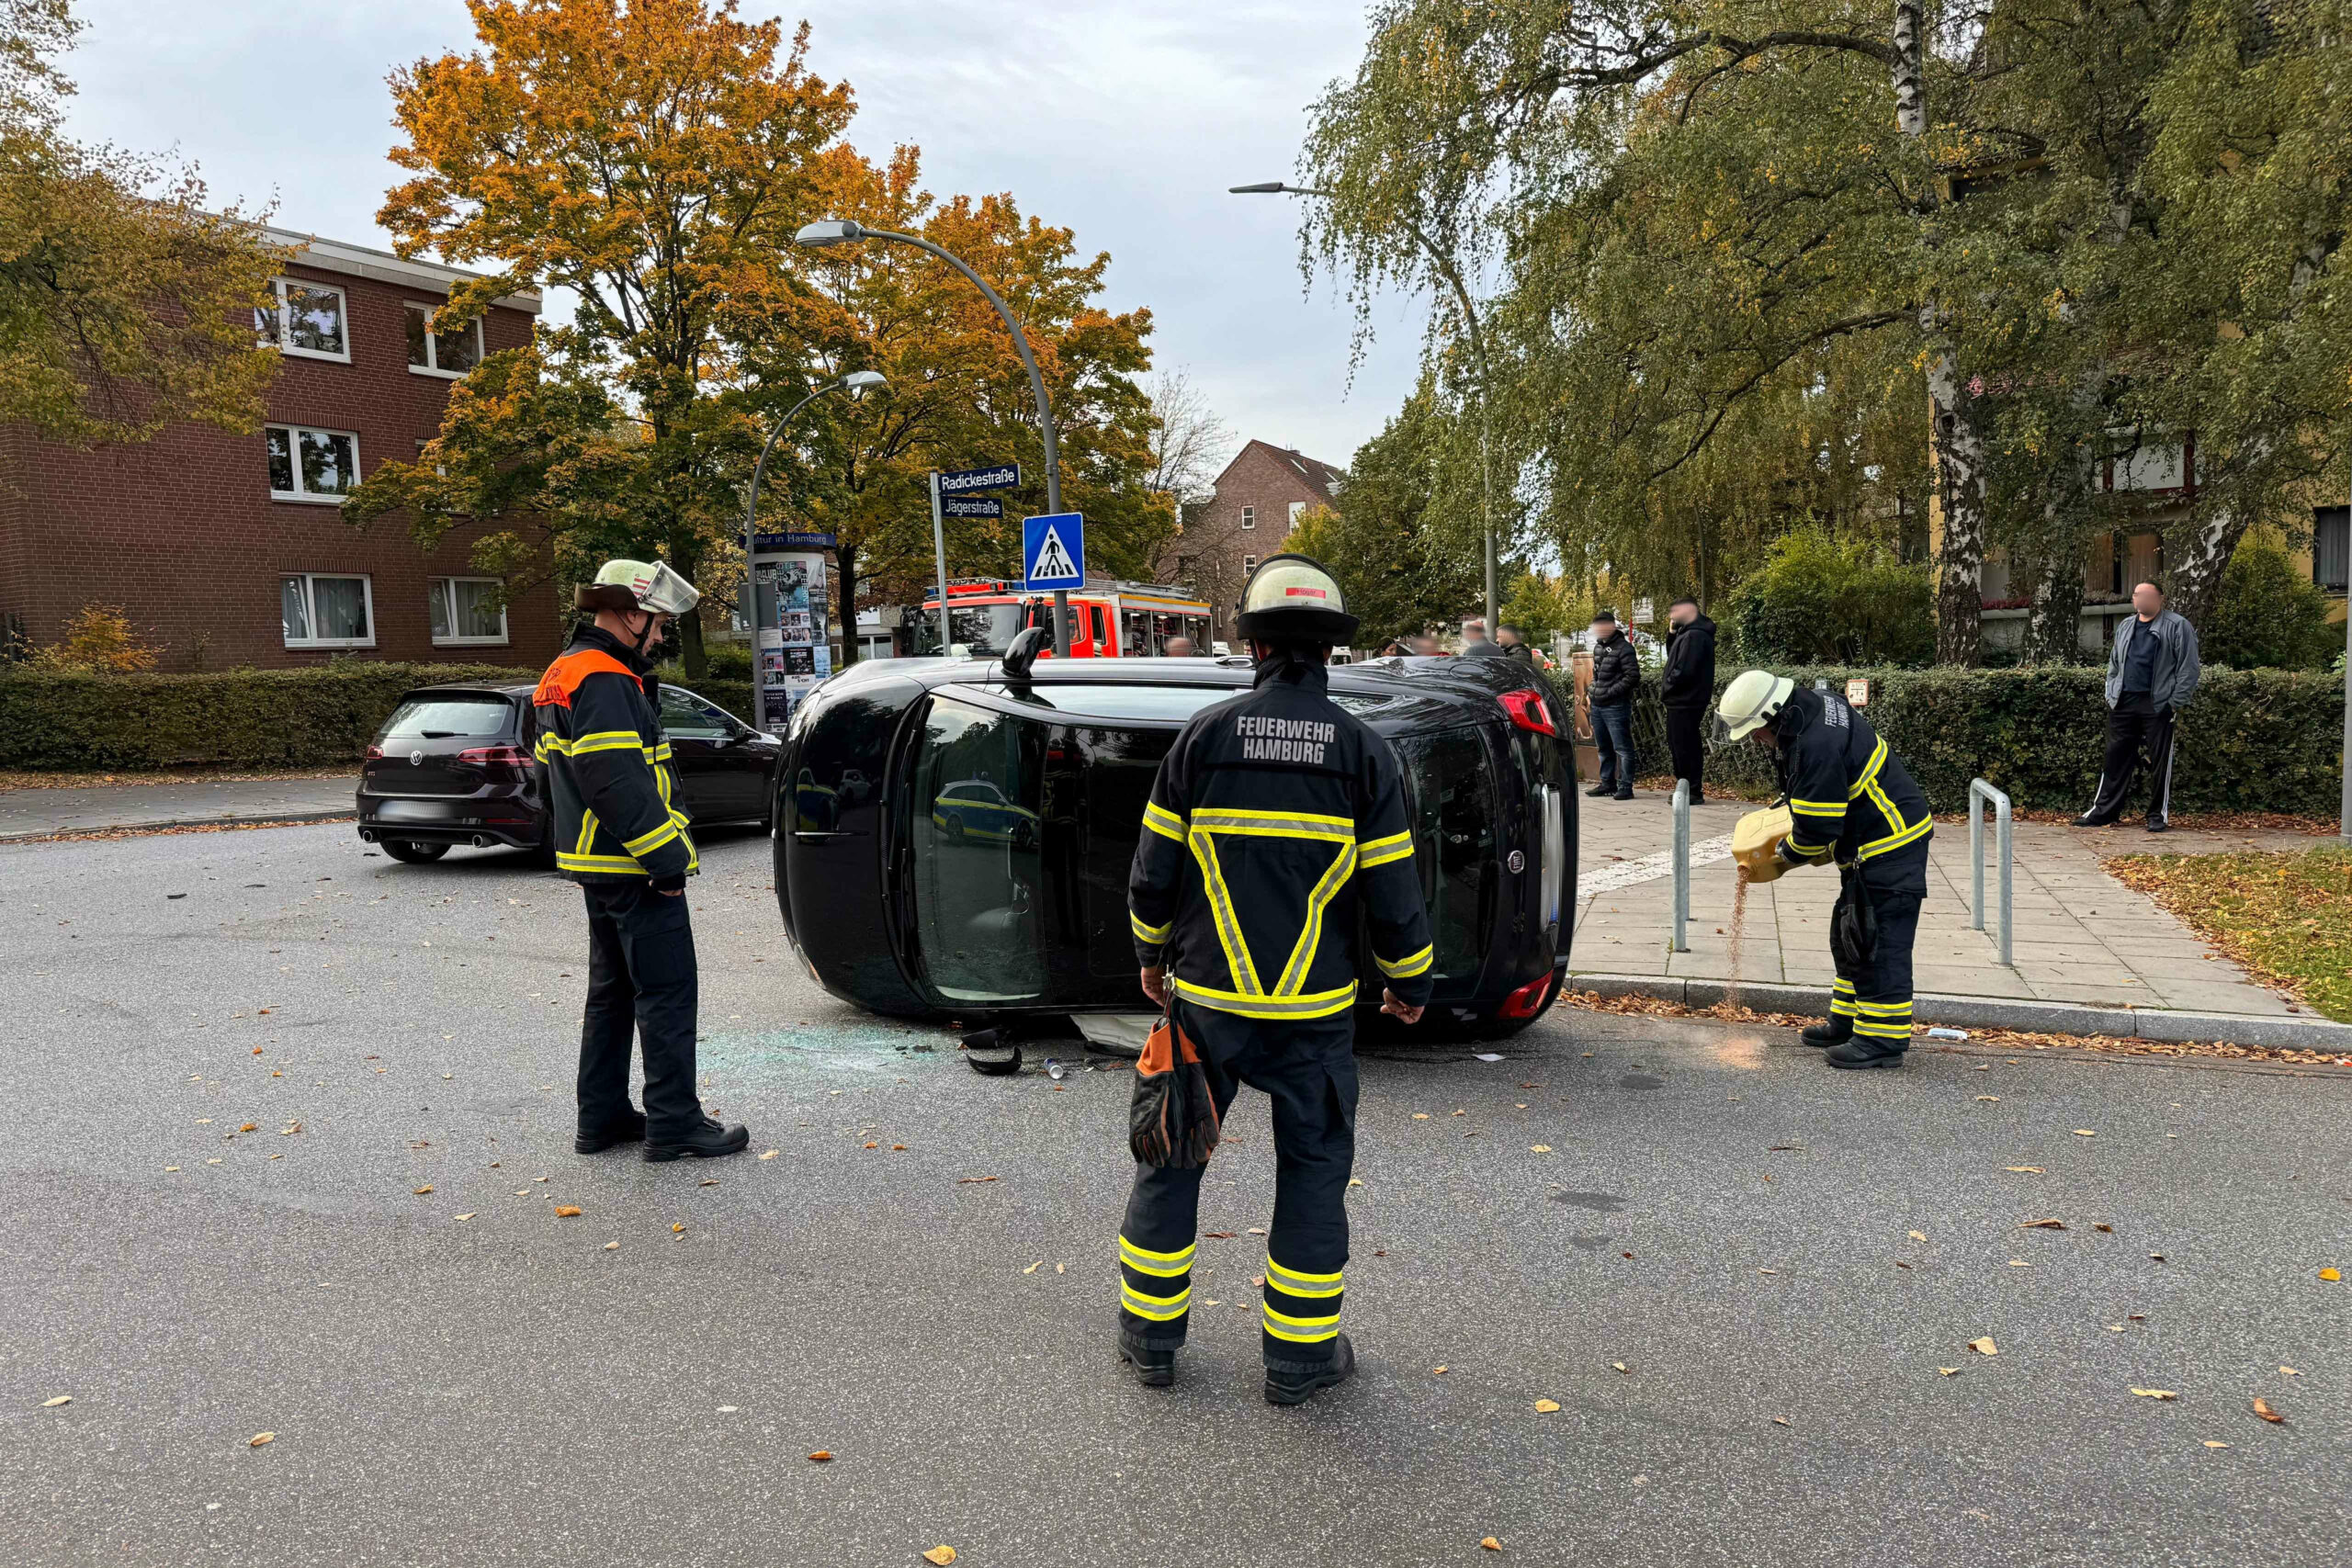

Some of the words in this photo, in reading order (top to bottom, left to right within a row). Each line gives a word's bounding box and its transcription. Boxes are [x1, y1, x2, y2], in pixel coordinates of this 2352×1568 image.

[942, 468, 1015, 491] Radickestraße
[945, 499, 1000, 517] Jägerstraße
[753, 536, 772, 545] ultur
[787, 534, 827, 545] Hamburg
[1237, 716, 1335, 743] FEUERWEHR
[1243, 738, 1326, 764] HAMBURG
[1512, 855, 1521, 869] FIAT
